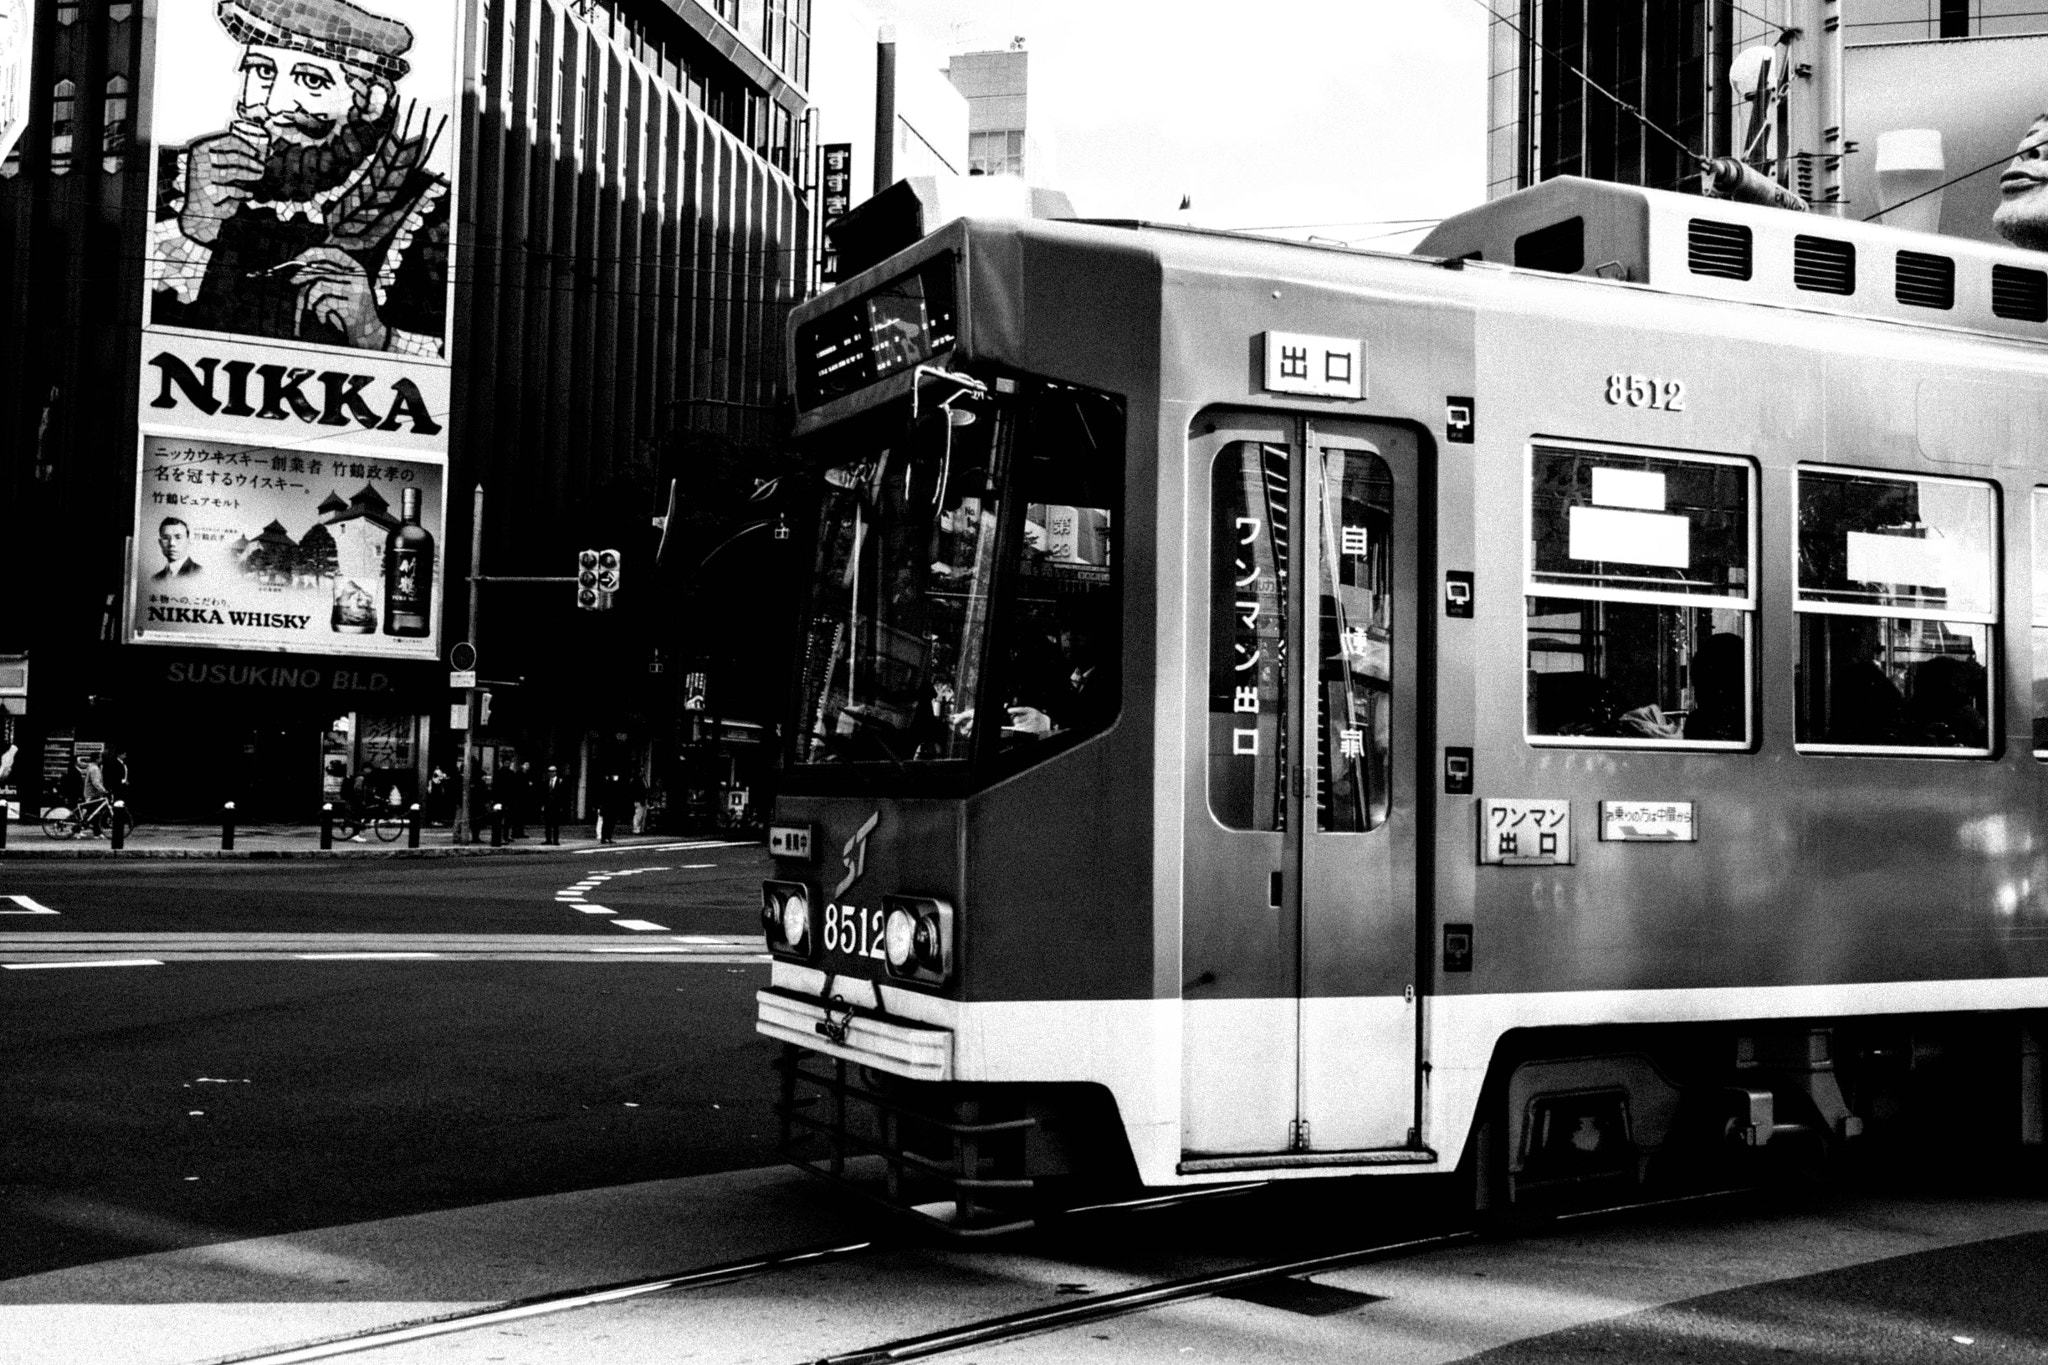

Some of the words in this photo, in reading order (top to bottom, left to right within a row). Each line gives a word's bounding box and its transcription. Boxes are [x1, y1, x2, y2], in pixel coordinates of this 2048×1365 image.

[1280, 345, 1351, 384] 出口
[148, 352, 442, 436] NIKKA
[1604, 373, 1687, 411] 8512
[147, 605, 225, 625] NIKKA
[228, 611, 311, 630] WHISKY
[167, 662, 320, 688] SUSUKINO
[332, 670, 395, 692] BLD.
[1491, 806, 1566, 828] ワンマン
[1499, 832, 1557, 856] 出口
[824, 903, 886, 960] 8512
